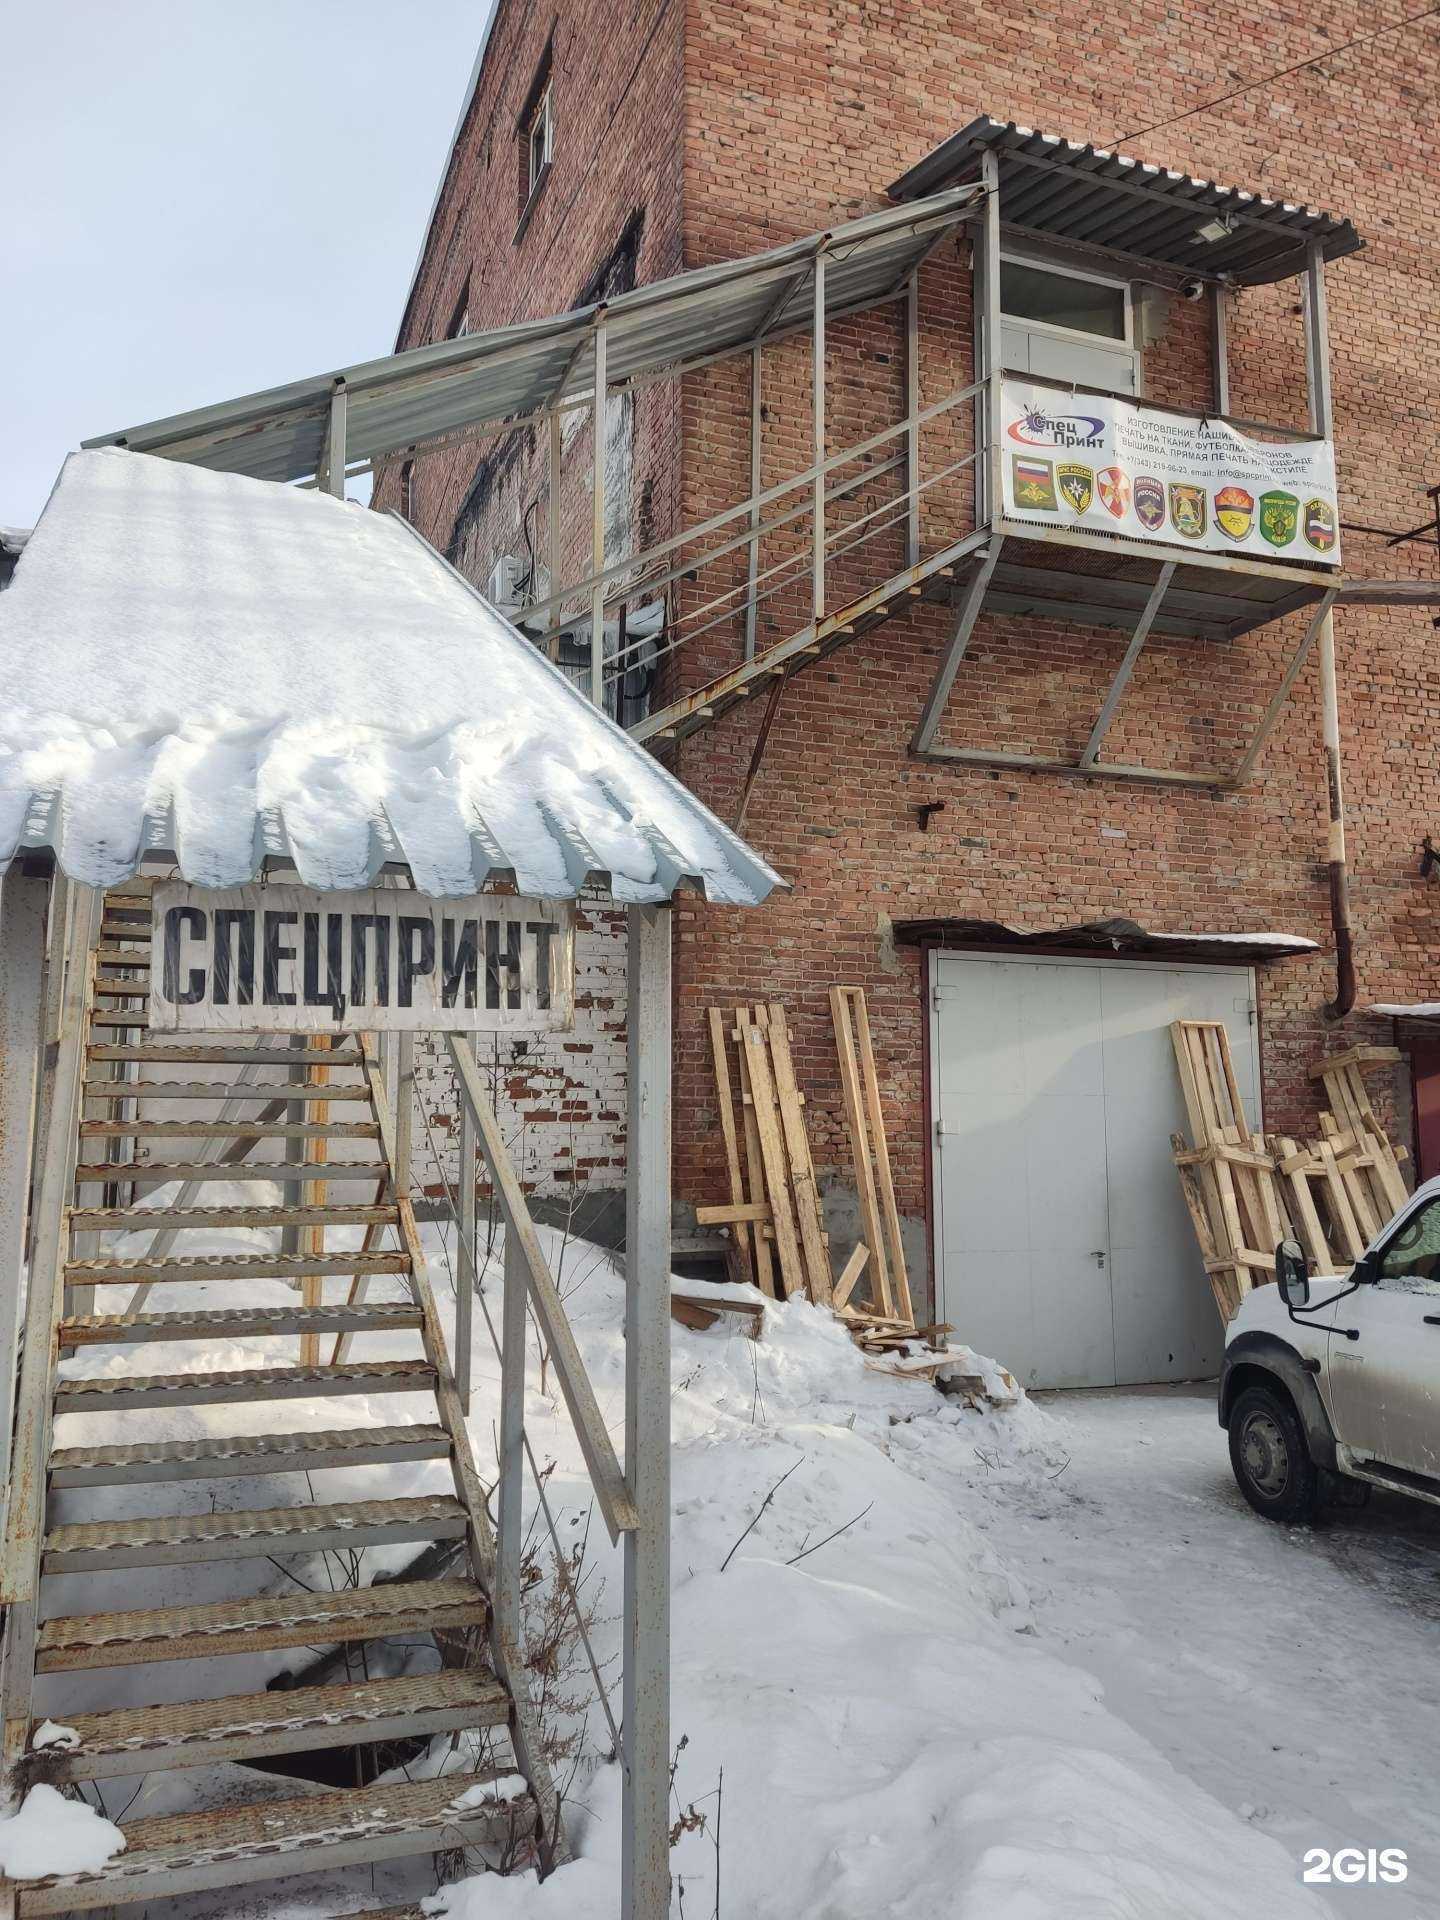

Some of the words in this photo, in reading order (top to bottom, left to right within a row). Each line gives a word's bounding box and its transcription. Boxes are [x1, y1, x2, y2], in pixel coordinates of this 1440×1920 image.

[1033, 415, 1077, 436] Спец
[1114, 422, 1145, 440] ПЕЧАТЬ
[1147, 433, 1159, 442] НА
[1127, 416, 1195, 438] ИЗГОТОВЛЕНИЕ
[1054, 431, 1104, 448] Принт
[1170, 449, 1208, 461] ПРЯМАЯ
[1211, 453, 1248, 464] ПЕЧАТЬ
[162, 906, 560, 1021] СПЕЦПРИНТ
